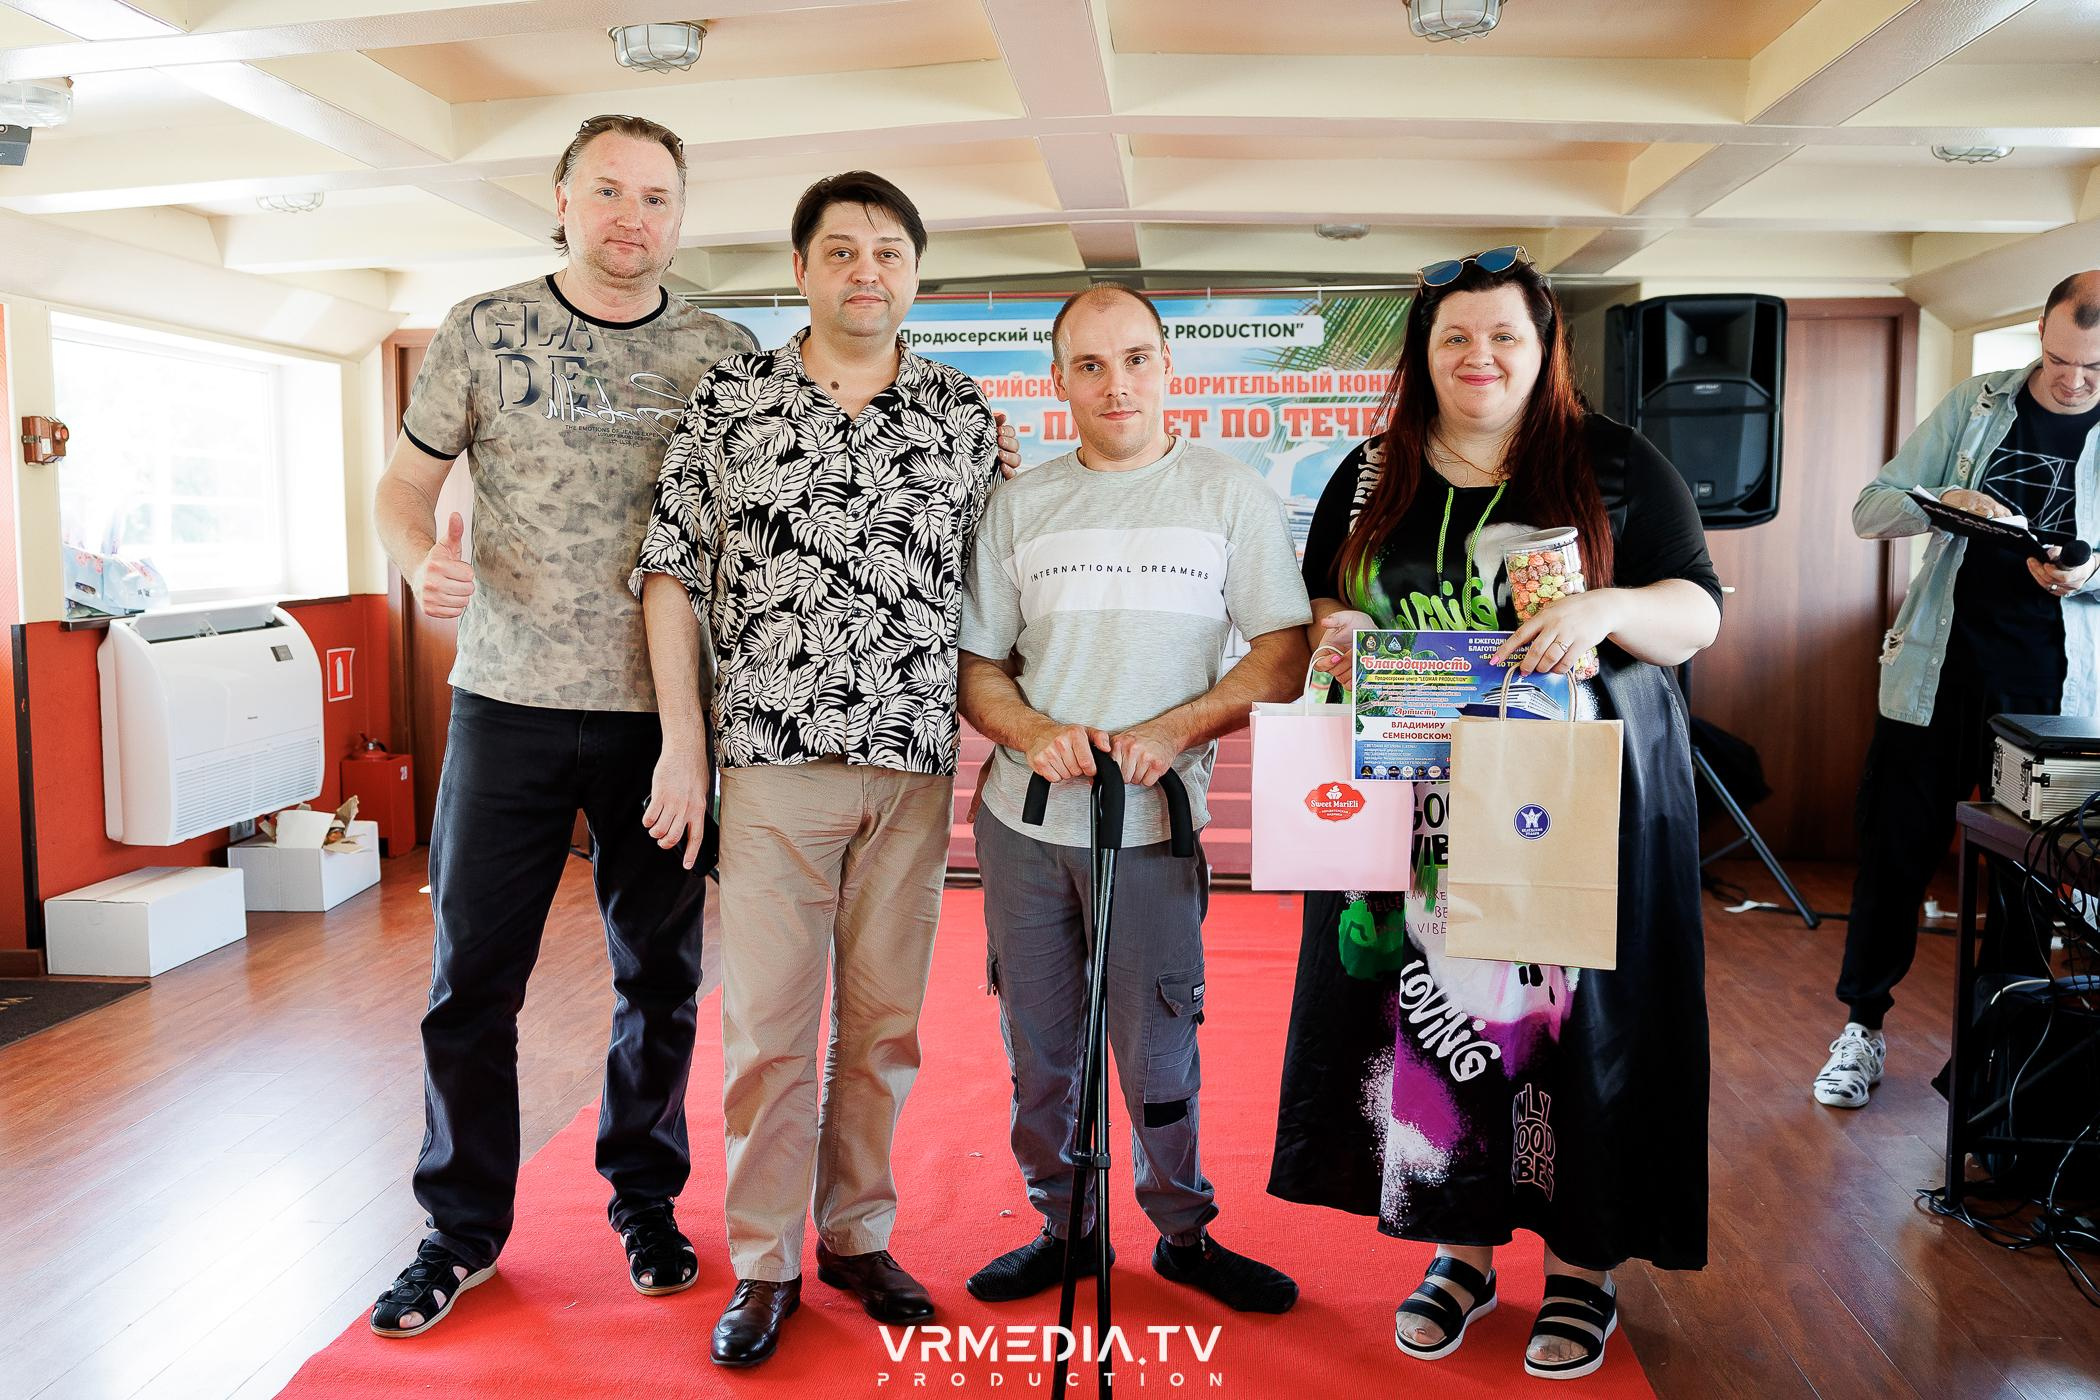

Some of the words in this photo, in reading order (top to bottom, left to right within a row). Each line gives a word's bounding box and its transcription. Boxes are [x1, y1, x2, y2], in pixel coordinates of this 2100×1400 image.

[471, 298, 607, 352] GLA
[1175, 323, 1304, 339] PRODUCTION"
[901, 328, 1028, 346] Продюсерский
[1169, 371, 1331, 395] ВОРИТЕЛЬНЫЙ
[578, 425, 610, 433] EMOTIONS
[1221, 408, 1270, 438] ПО
[1283, 407, 1396, 437] ТЕЧЕ
[1030, 564, 1132, 583] INTERNATIONAL
[1141, 565, 1209, 580] DREAMERS
[1361, 656, 1471, 673] Благодарность
[1394, 707, 1438, 716] Артисту
[1391, 721, 1446, 730] ВЛАДИМИРУ
[1310, 799, 1333, 808] Sweet
[1333, 799, 1359, 808] MariEli
